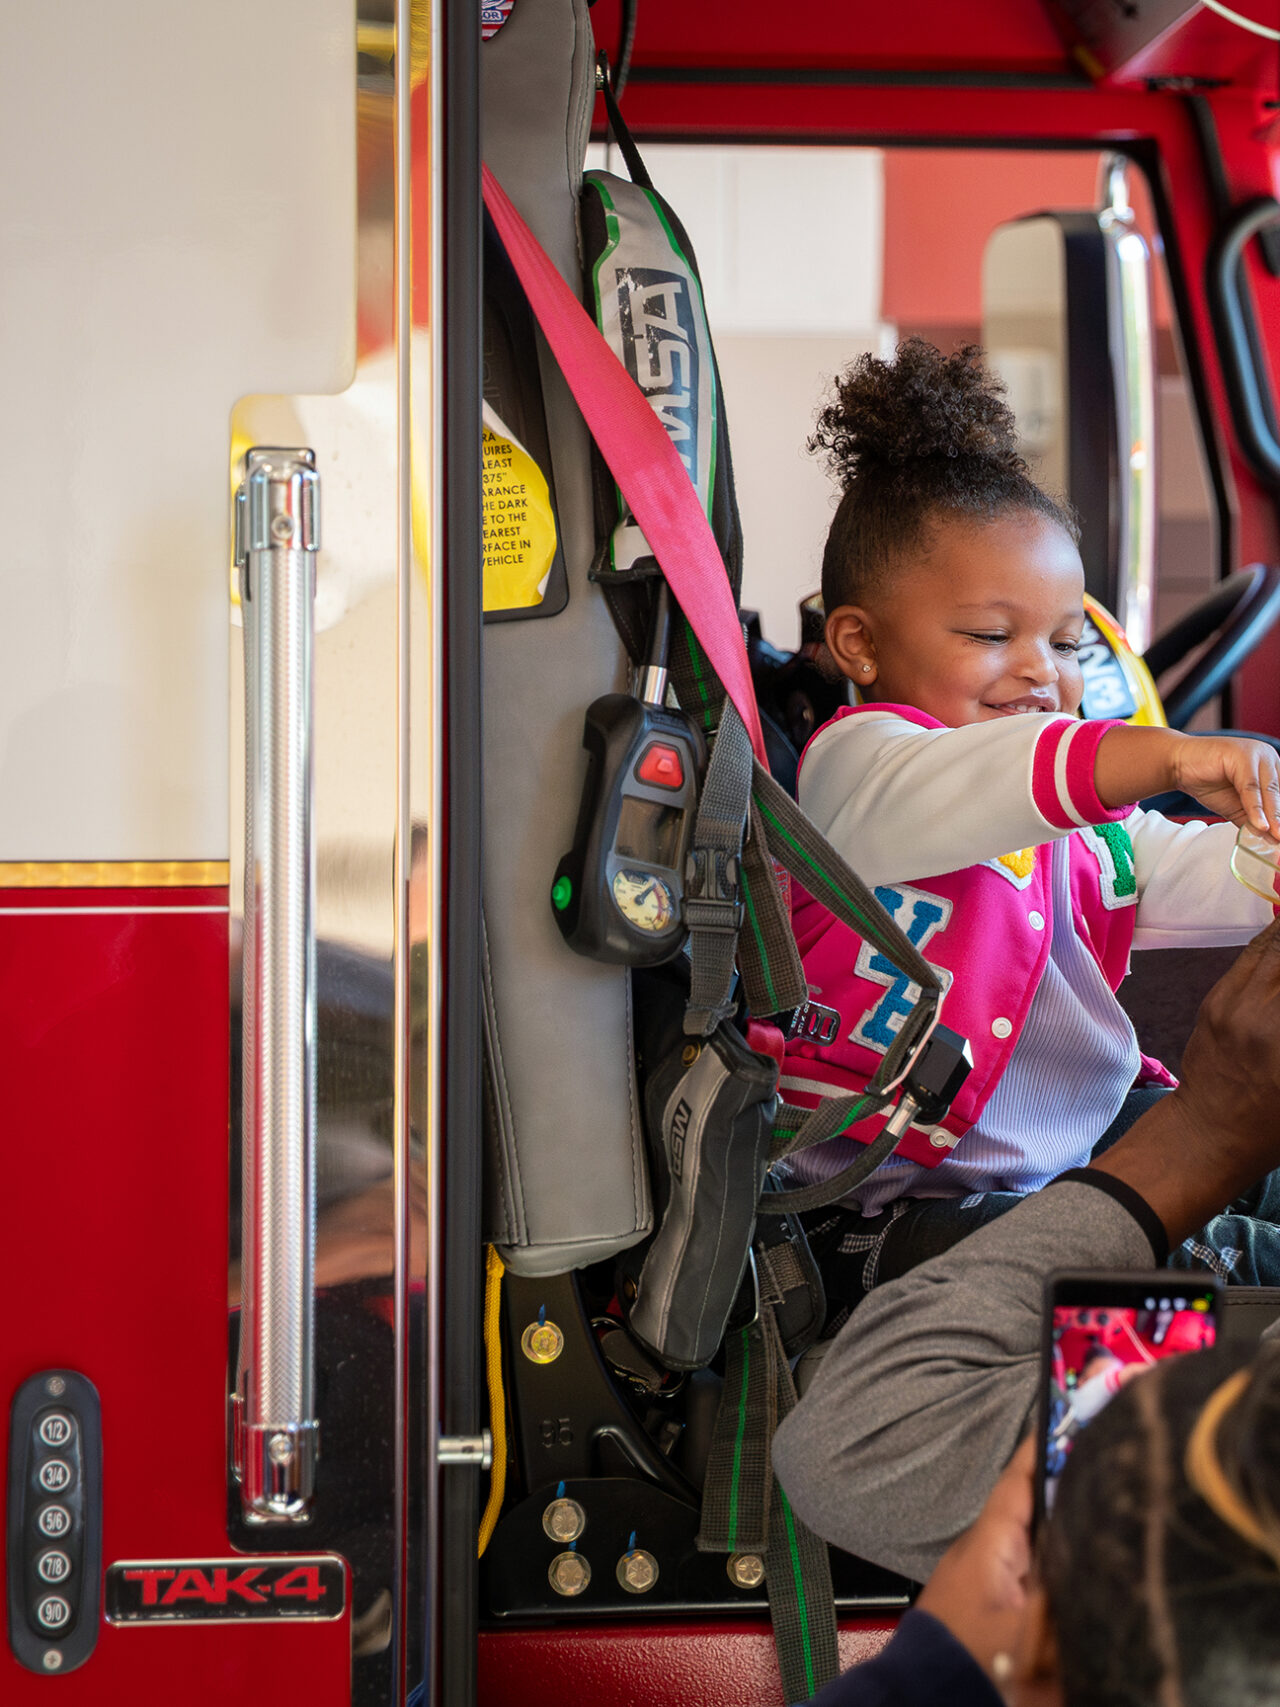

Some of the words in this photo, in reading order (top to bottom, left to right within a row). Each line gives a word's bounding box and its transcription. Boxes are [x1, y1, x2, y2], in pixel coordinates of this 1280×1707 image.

[498, 498, 528, 510] DARK
[490, 513, 505, 524] TO
[508, 512, 527, 522] THE
[520, 539, 531, 549] IN
[47, 1421, 63, 1440] 1/2
[47, 1467, 63, 1485] 3/4
[46, 1513, 63, 1530] 5/6
[46, 1558, 63, 1576] 7/8
[124, 1566, 327, 1605] TAK-4
[45, 1603, 62, 1621] 9/0
